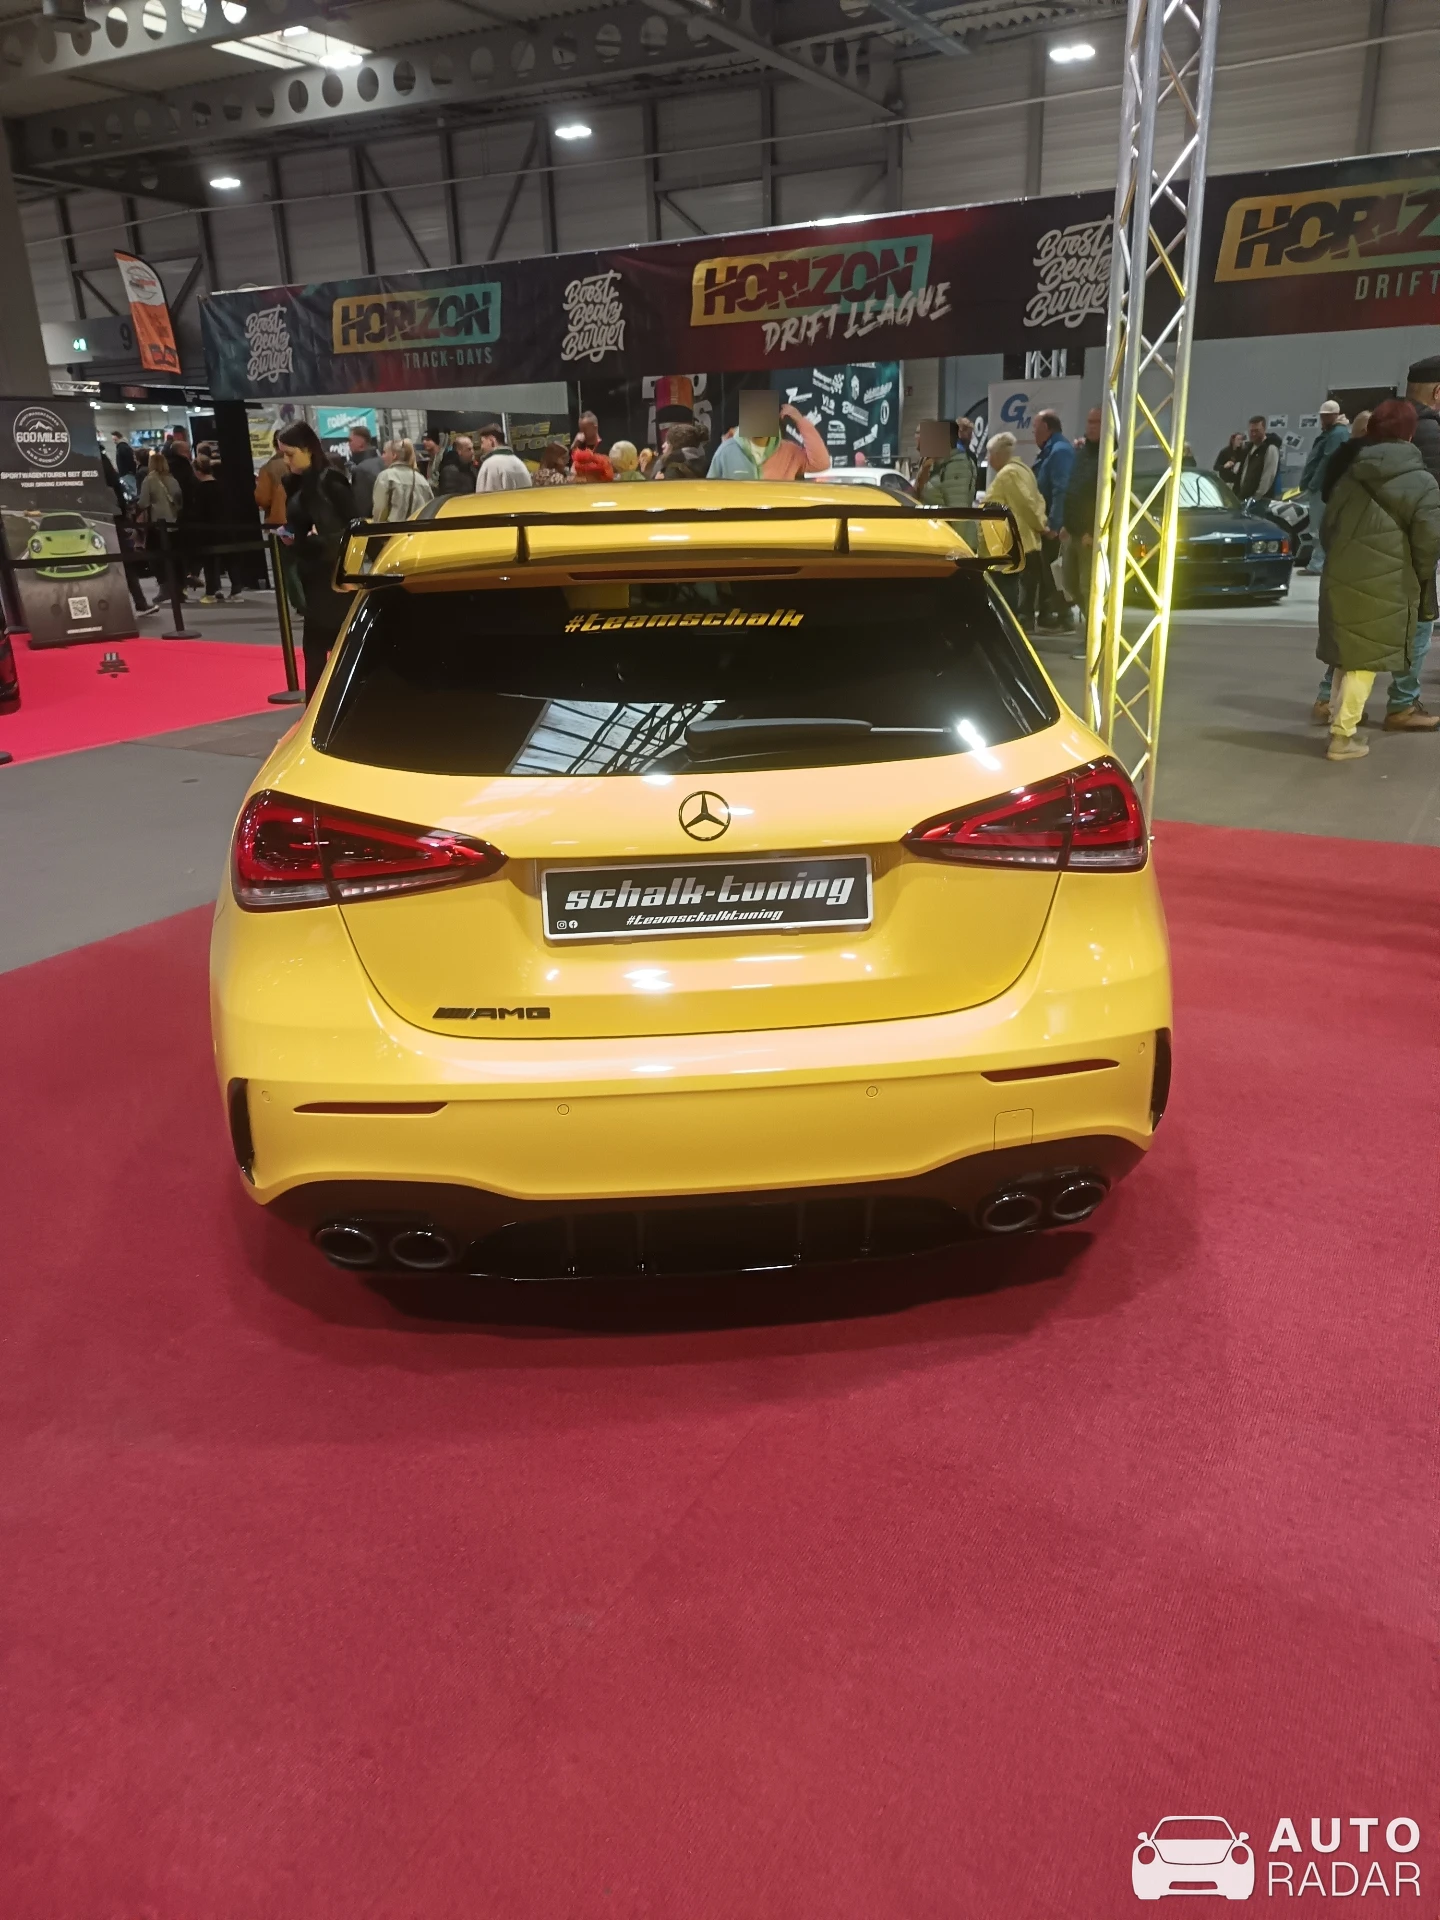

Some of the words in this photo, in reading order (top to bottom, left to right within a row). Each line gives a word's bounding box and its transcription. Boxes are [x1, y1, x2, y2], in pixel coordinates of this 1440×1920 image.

[1033, 214, 1114, 266] Boost
[562, 269, 622, 310] Boost
[703, 246, 918, 316] HORIZON
[1354, 269, 1440, 300] DRIFT
[244, 304, 288, 338] Boost
[341, 291, 492, 346] HORIZON
[762, 304, 840, 355] DRIFT
[844, 282, 951, 339] LEAGUE
[1023, 279, 1110, 328] Burge
[403, 346, 493, 369] TRACK-DAYS
[561, 319, 626, 362] Burger
[247, 346, 294, 383] Burger
[564, 608, 805, 633] #teamschalk
[564, 872, 855, 911] schalk-tuning
[626, 909, 784, 926] #teamschalktuning
[470, 1007, 550, 1020] AMG
